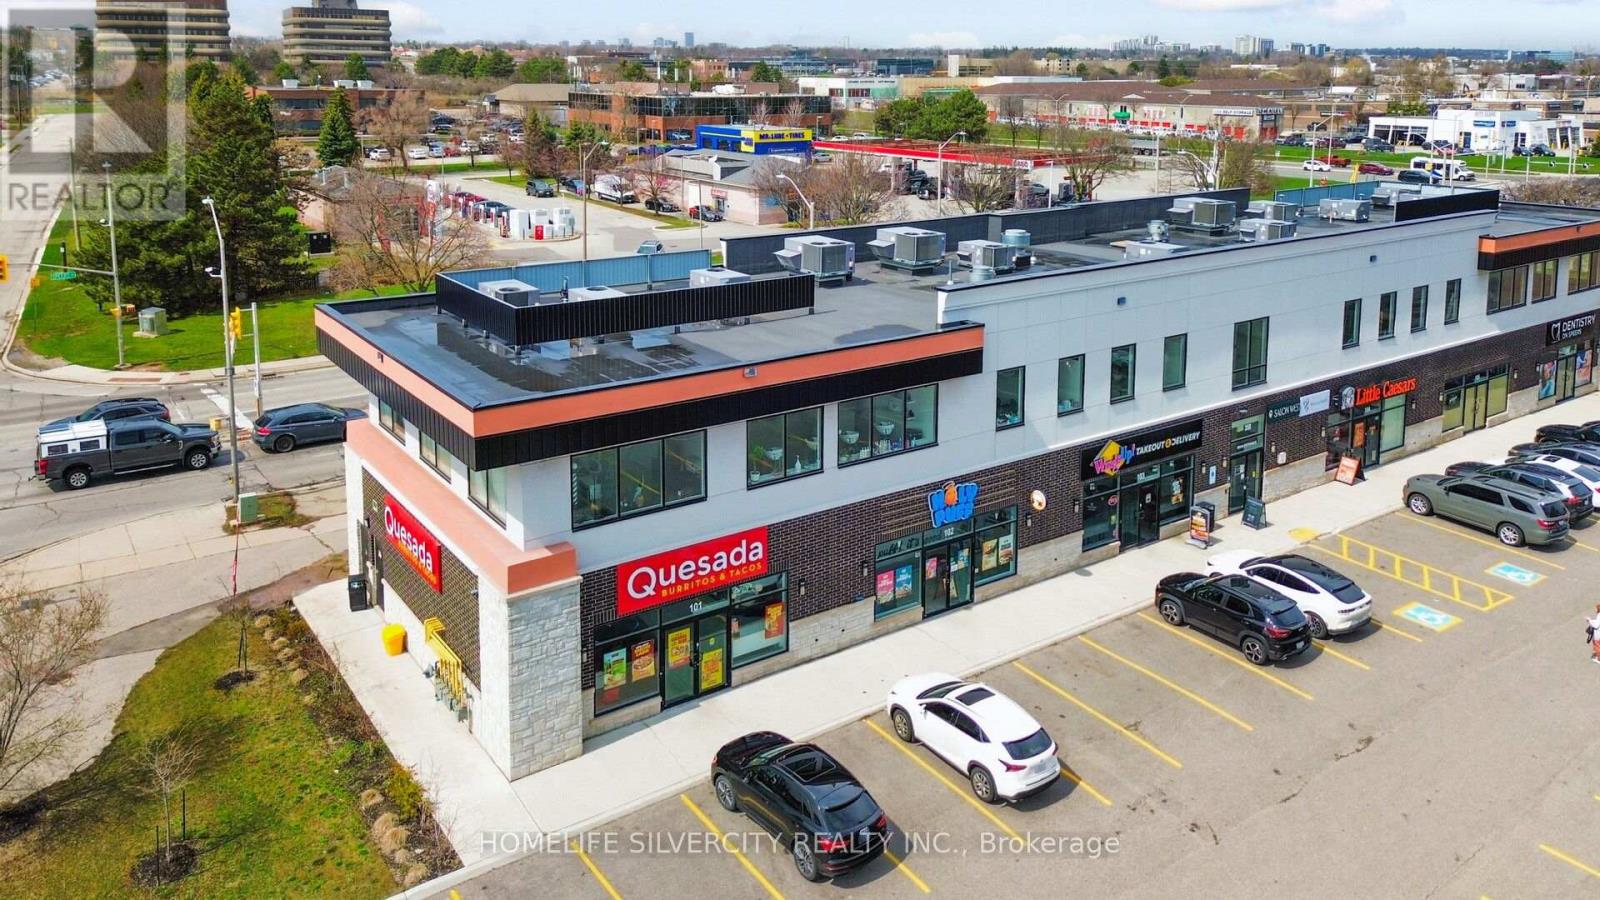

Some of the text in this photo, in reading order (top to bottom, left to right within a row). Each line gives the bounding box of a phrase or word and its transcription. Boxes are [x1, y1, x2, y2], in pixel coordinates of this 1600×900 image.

[1562, 314, 1596, 331] DENTISTRY
[1356, 378, 1417, 406] Little Caesars
[1273, 406, 1290, 418] SALON
[1136, 440, 1165, 455] TAKEOUT
[1171, 431, 1200, 446] DELIVERY
[385, 506, 433, 573] Quesada
[627, 539, 763, 599] Quesada
[661, 562, 763, 598] BURRITOS & TACOS
[689, 601, 703, 613] 101
